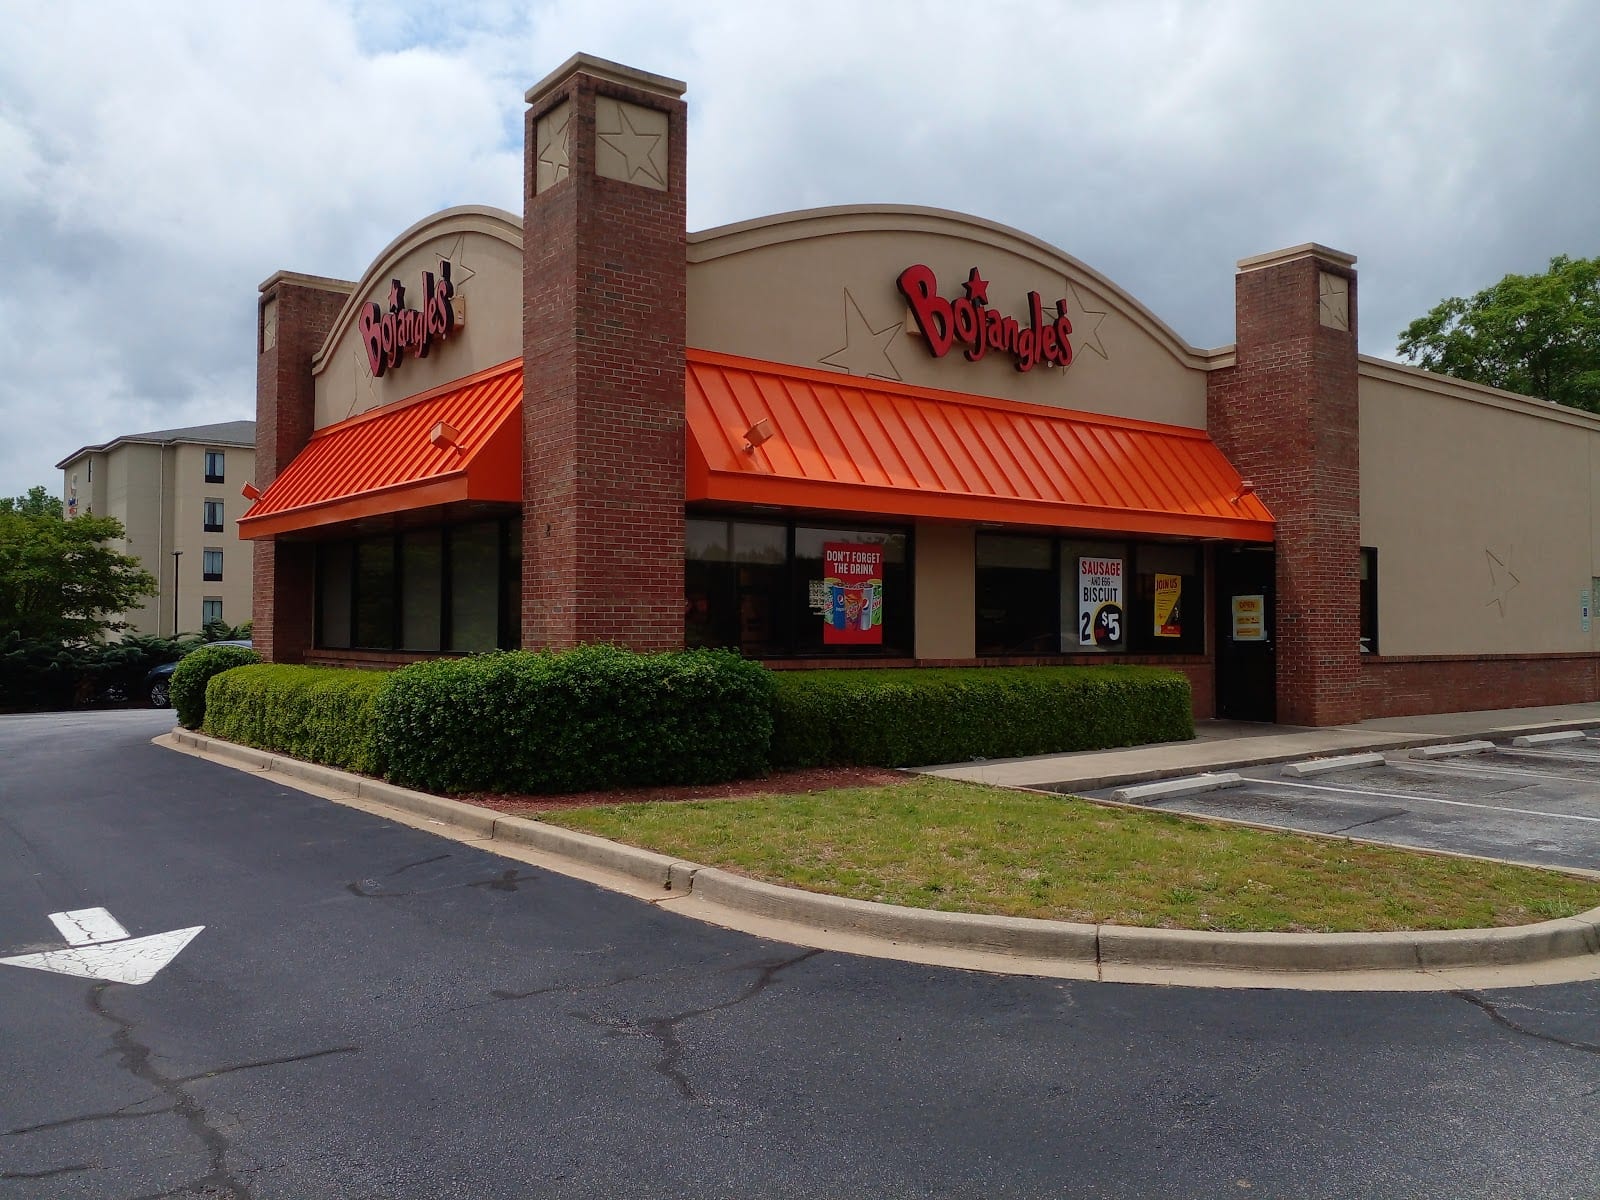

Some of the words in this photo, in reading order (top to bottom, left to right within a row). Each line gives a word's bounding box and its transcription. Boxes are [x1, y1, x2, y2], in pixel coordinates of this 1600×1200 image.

[826, 550, 850, 562] DON'T
[852, 552, 880, 564] FORGET
[833, 562, 849, 574] THE
[850, 563, 874, 575] DRINK
[1081, 561, 1121, 577] SAUSAGE
[1101, 577, 1111, 587] EGG
[1156, 579, 1169, 591] JOIN
[1170, 576, 1178, 589] US
[1083, 587, 1118, 603] BISCUIT
[1081, 611, 1091, 642] 2
[1101, 610, 1120, 641] $5
